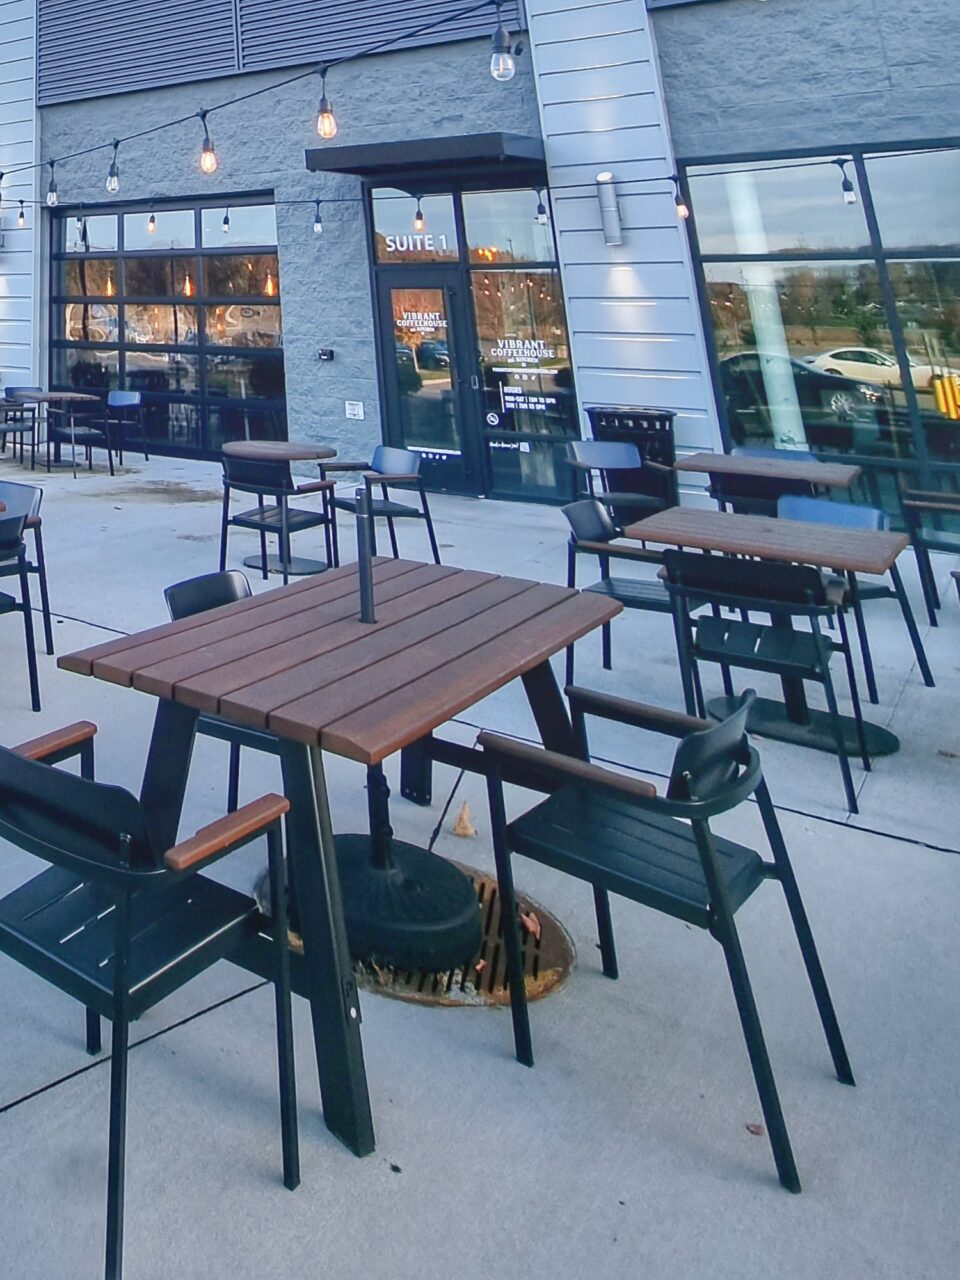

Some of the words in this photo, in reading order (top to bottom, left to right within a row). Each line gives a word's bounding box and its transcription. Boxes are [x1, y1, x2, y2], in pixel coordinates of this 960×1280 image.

[385, 234, 434, 252] SUITE
[439, 234, 447, 250] 1
[402, 312, 440, 320] VIBRANT
[497, 339, 544, 349] VIBRANT
[491, 348, 555, 358] COFFEEHOUSE
